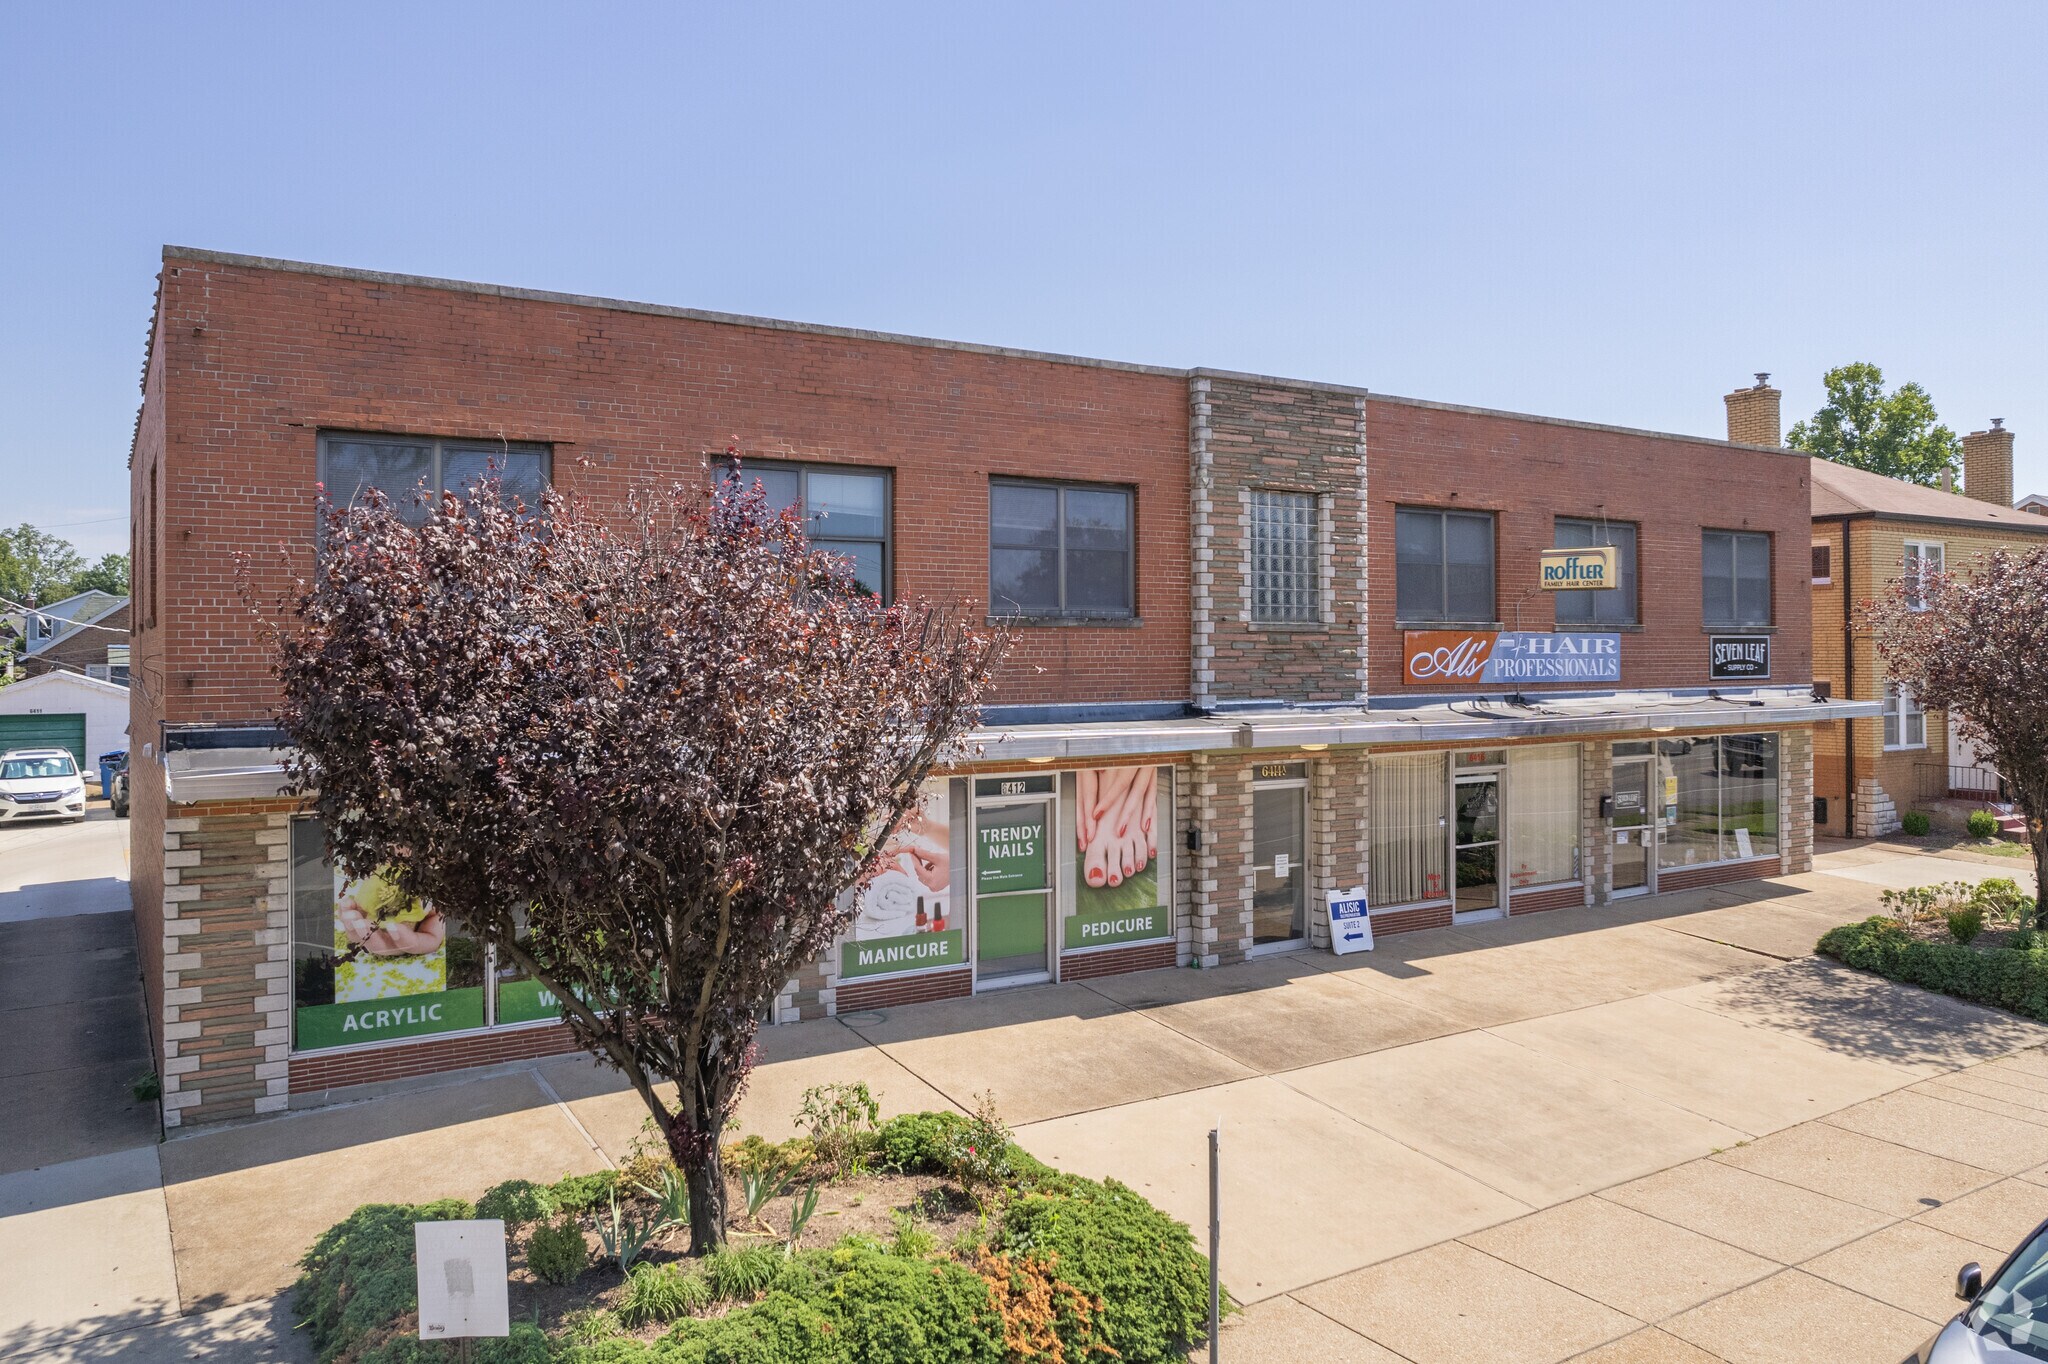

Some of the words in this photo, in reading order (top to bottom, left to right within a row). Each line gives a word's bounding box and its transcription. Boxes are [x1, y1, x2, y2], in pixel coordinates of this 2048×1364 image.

[1527, 637, 1617, 655] HAIR
[1715, 643, 1743, 665] SEVEN
[1745, 643, 1766, 664] LEAF
[1410, 636, 1489, 678] Al's
[1493, 658, 1617, 677] PROFESSIONALS
[1002, 782, 1025, 795] 6412
[981, 825, 1041, 843] TRENDY
[989, 842, 1034, 859] NAILS
[1339, 902, 1360, 913] ALISIC
[1082, 916, 1152, 937] PEDICURE
[1343, 921, 1356, 929] SUITE
[859, 941, 949, 965] MANICURE
[342, 1003, 442, 1032] ACRYLIC
